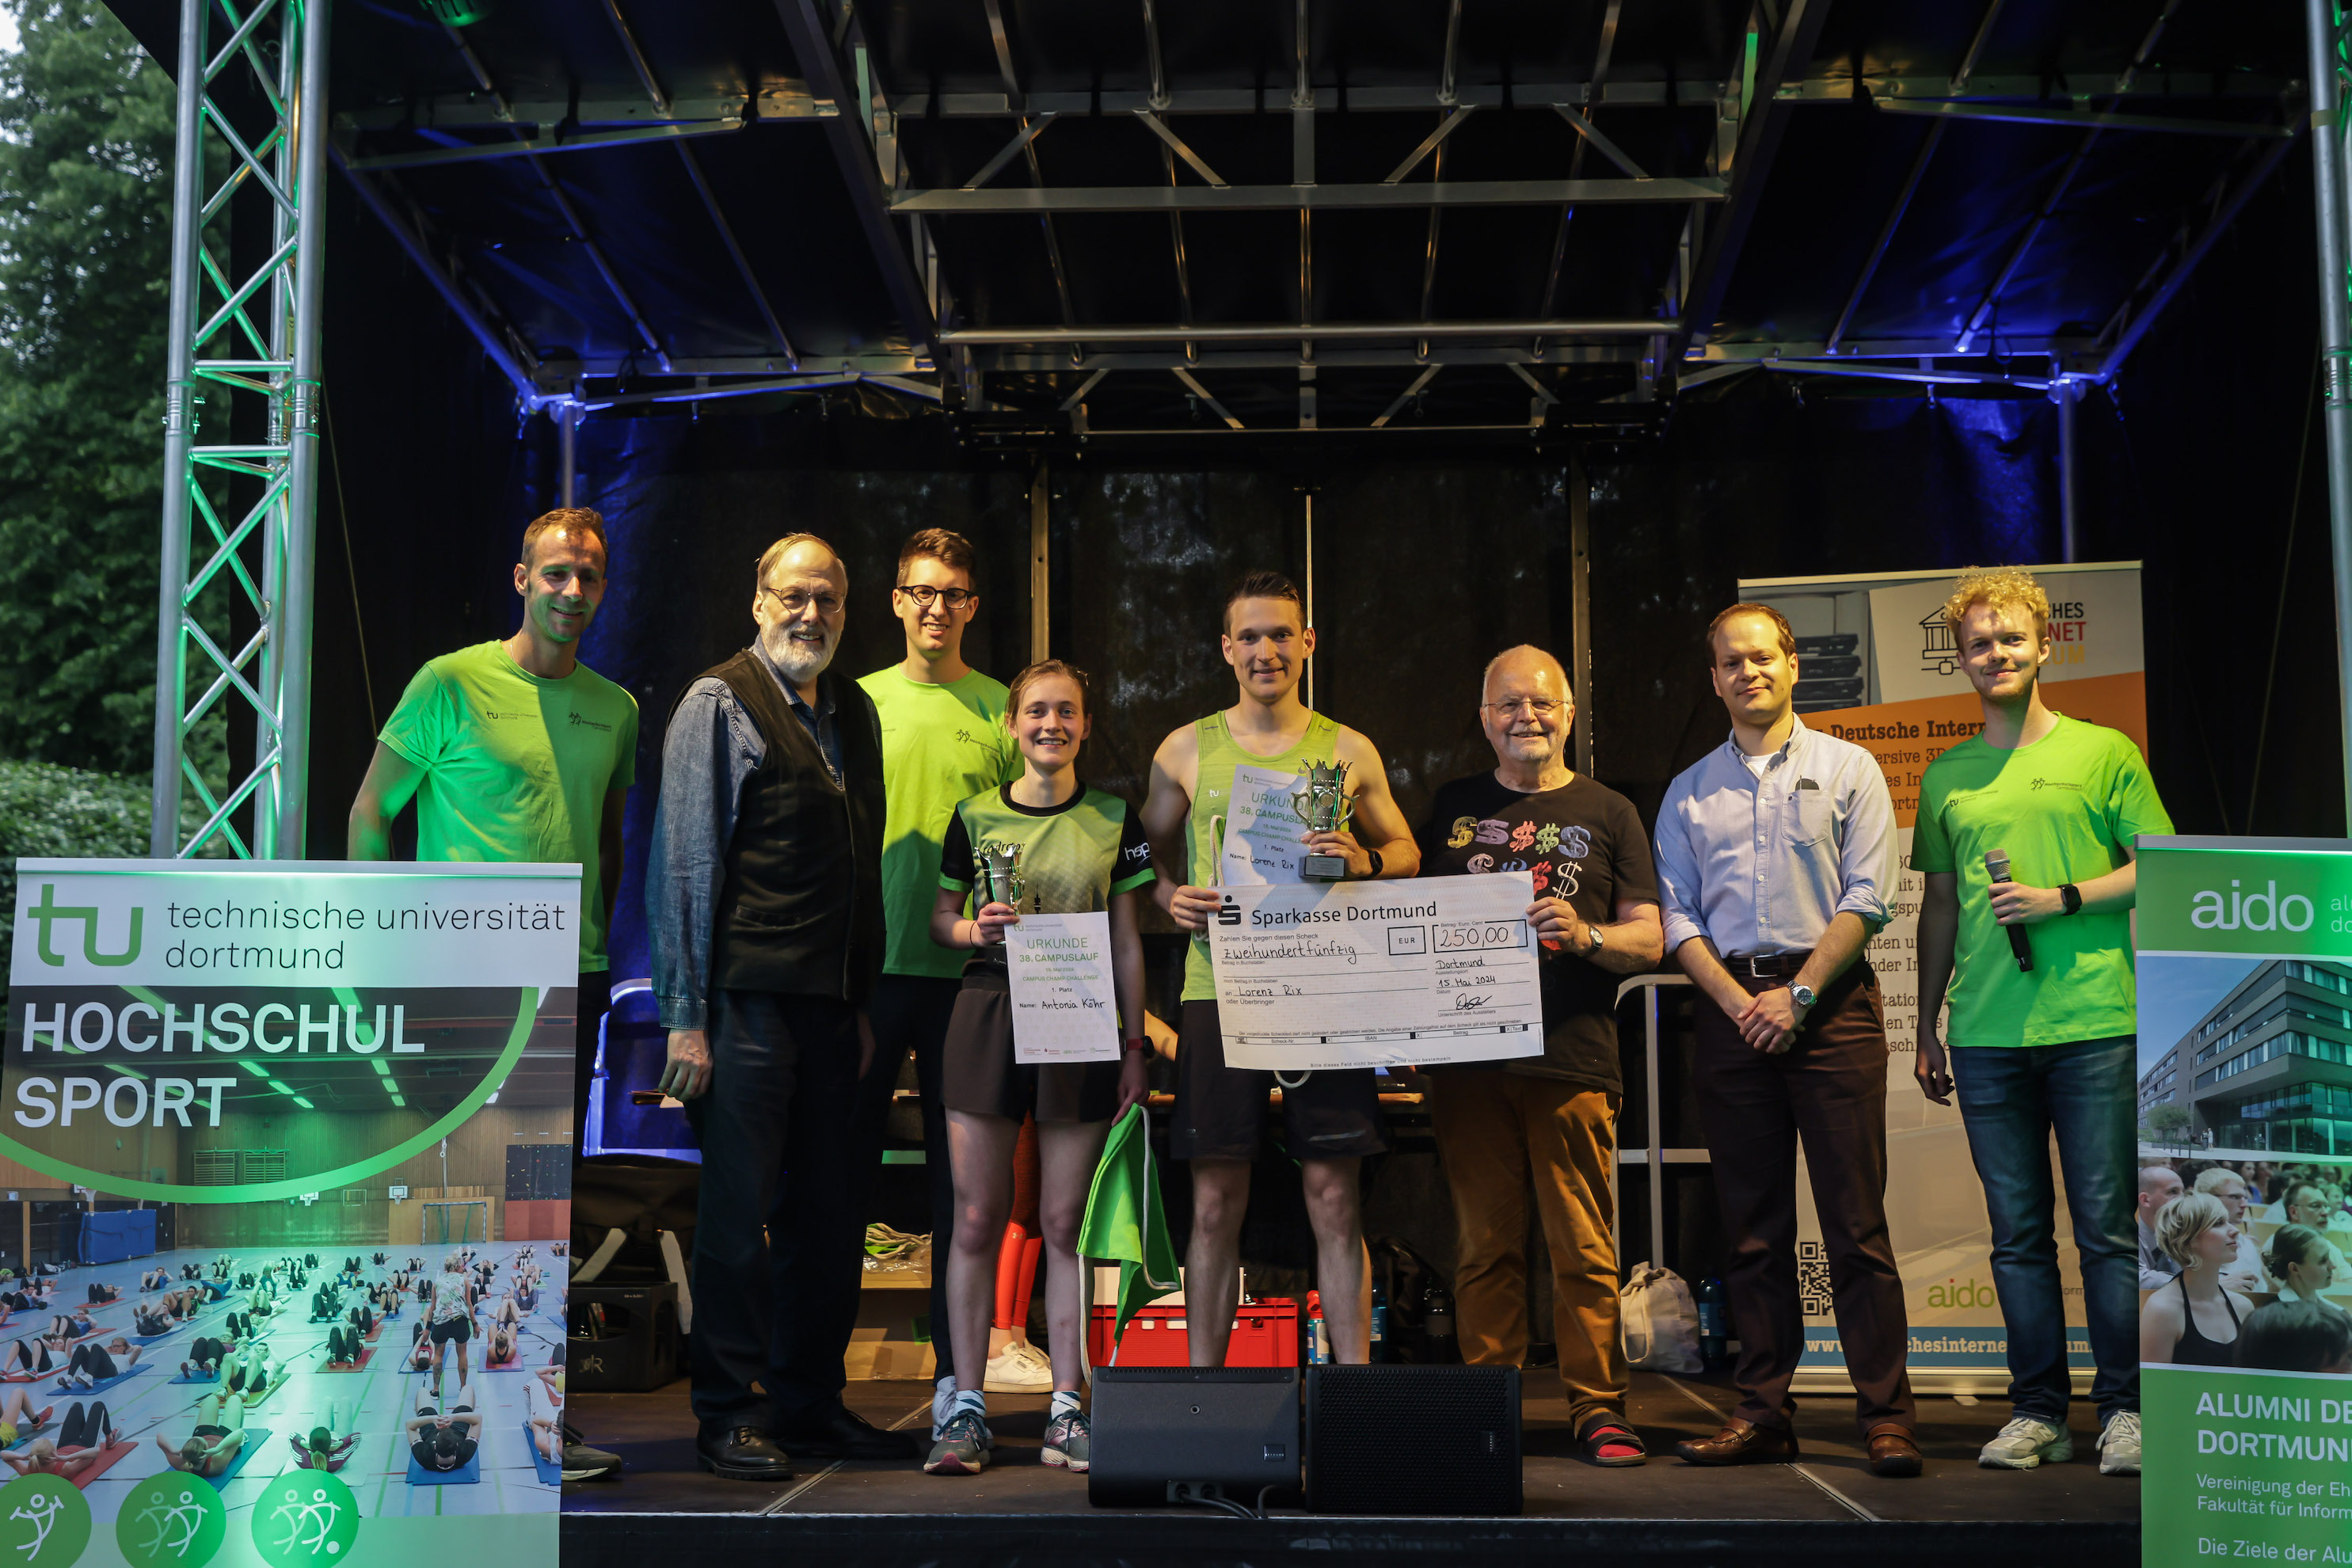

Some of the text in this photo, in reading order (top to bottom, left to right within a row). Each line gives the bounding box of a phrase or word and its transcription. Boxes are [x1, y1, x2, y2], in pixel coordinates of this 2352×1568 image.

[2048, 621, 2087, 641] NET
[2044, 645, 2085, 665] UM
[1831, 721, 1920, 740] Deutsche
[1876, 750, 1920, 765] ersive
[1886, 775, 1901, 786] es
[1240, 805, 1253, 815] 38.
[1125, 842, 1150, 861] hsp
[1252, 901, 1437, 928] Sparkasse Dortmund
[2190, 879, 2315, 932] aido
[27, 883, 143, 967] tu
[168, 901, 565, 932] technische universität
[2331, 917, 2352, 933] do
[1026, 938, 1088, 950] URKUNDE
[1440, 927, 1509, 948] 250,00
[165, 941, 344, 970] dortmund
[1019, 953, 1099, 963] 38. CAMPUSLAUF
[1435, 955, 1486, 969] Dortmund
[1239, 984, 1303, 996] Lorenz Rix
[1438, 975, 1496, 988] 15. Mai 2024
[1041, 998, 1078, 1010] Antonia
[1240, 998, 1275, 1007] Überbringer
[21, 1002, 425, 1055] HOCHSCHUL
[14, 1077, 238, 1129] SPORT
[1928, 1278, 1996, 1308] aido
[2195, 1391, 2352, 1424] ALUMNI DE
[2198, 1429, 2352, 1463] DORTMUN
[2196, 1473, 2352, 1498] Vereinigung der Eh
[2198, 1495, 2352, 1520] Fakultät für Inform
[2198, 1537, 2352, 1564] Die Ziele der Alu
